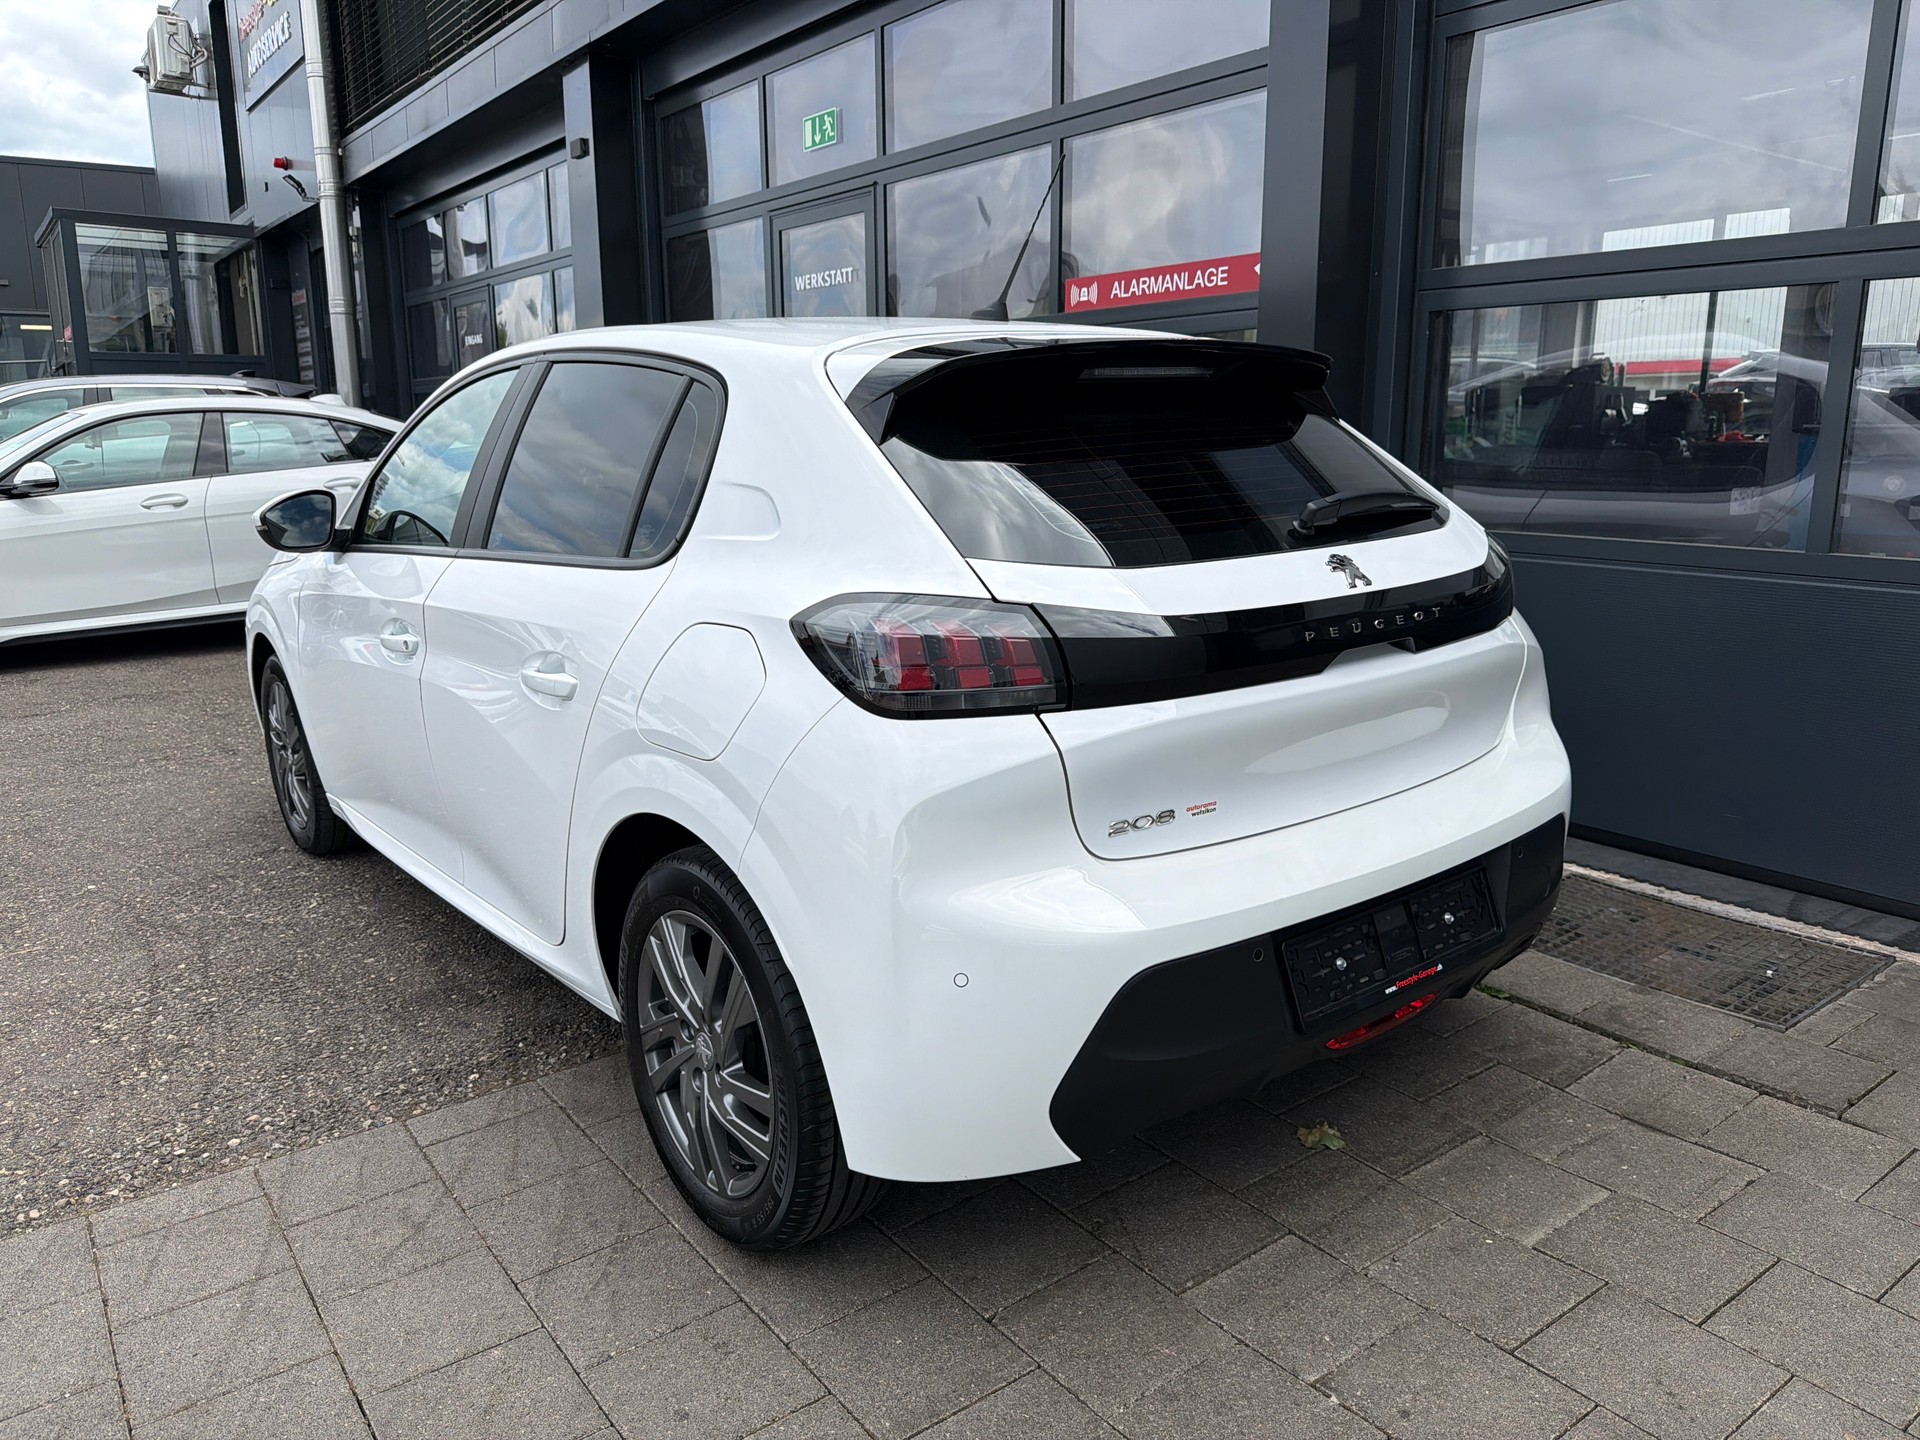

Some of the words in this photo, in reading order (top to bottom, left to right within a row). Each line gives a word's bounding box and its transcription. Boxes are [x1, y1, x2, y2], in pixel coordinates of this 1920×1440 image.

[247, 11, 290, 79] AUTOSERVICE
[795, 267, 853, 291] WERKSTATT
[1110, 265, 1229, 299] ALARMANLAGE
[464, 333, 483, 346] EINGANG
[1304, 607, 1441, 642] PEUGEOT
[1186, 800, 1217, 813] autorama
[1107, 808, 1176, 838] 208
[773, 1073, 789, 1191] MICHELIN
